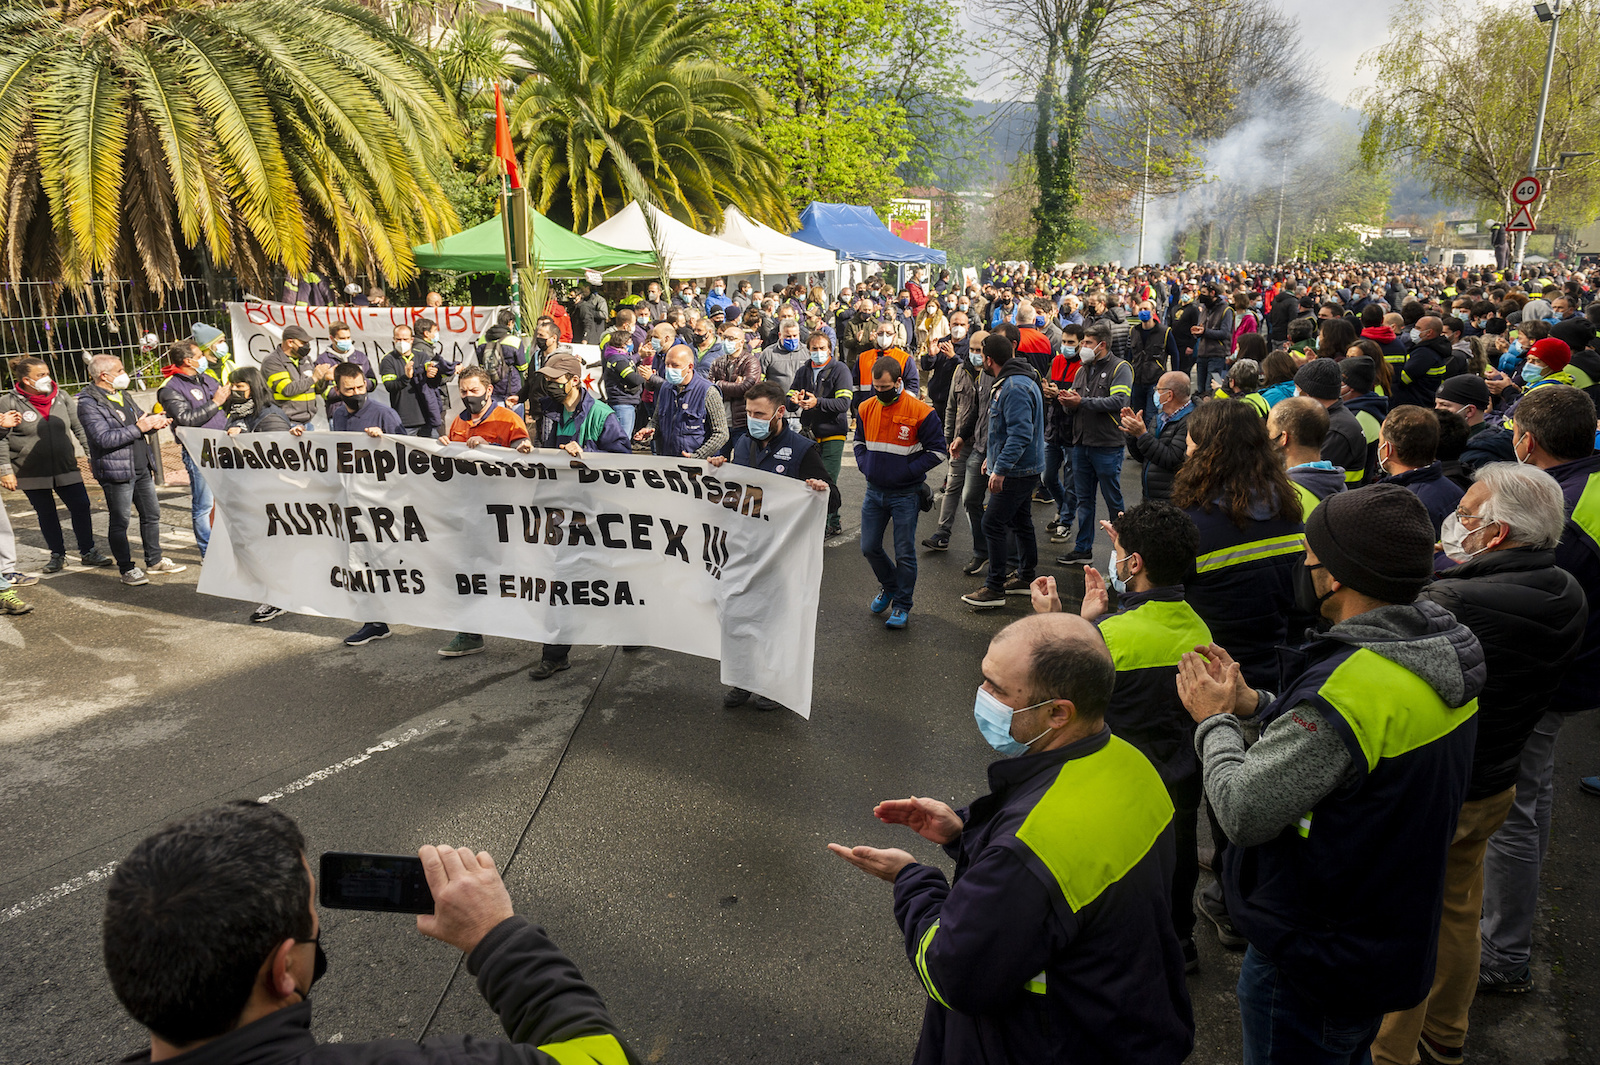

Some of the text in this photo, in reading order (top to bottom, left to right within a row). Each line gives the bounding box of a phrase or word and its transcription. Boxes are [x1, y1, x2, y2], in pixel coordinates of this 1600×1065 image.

[1518, 186, 1534, 195] 40
[266, 502, 429, 543] AURRERA
[486, 504, 690, 563] TUBACEX
[455, 573, 488, 595] DE
[499, 574, 645, 606] EMPRESA.
